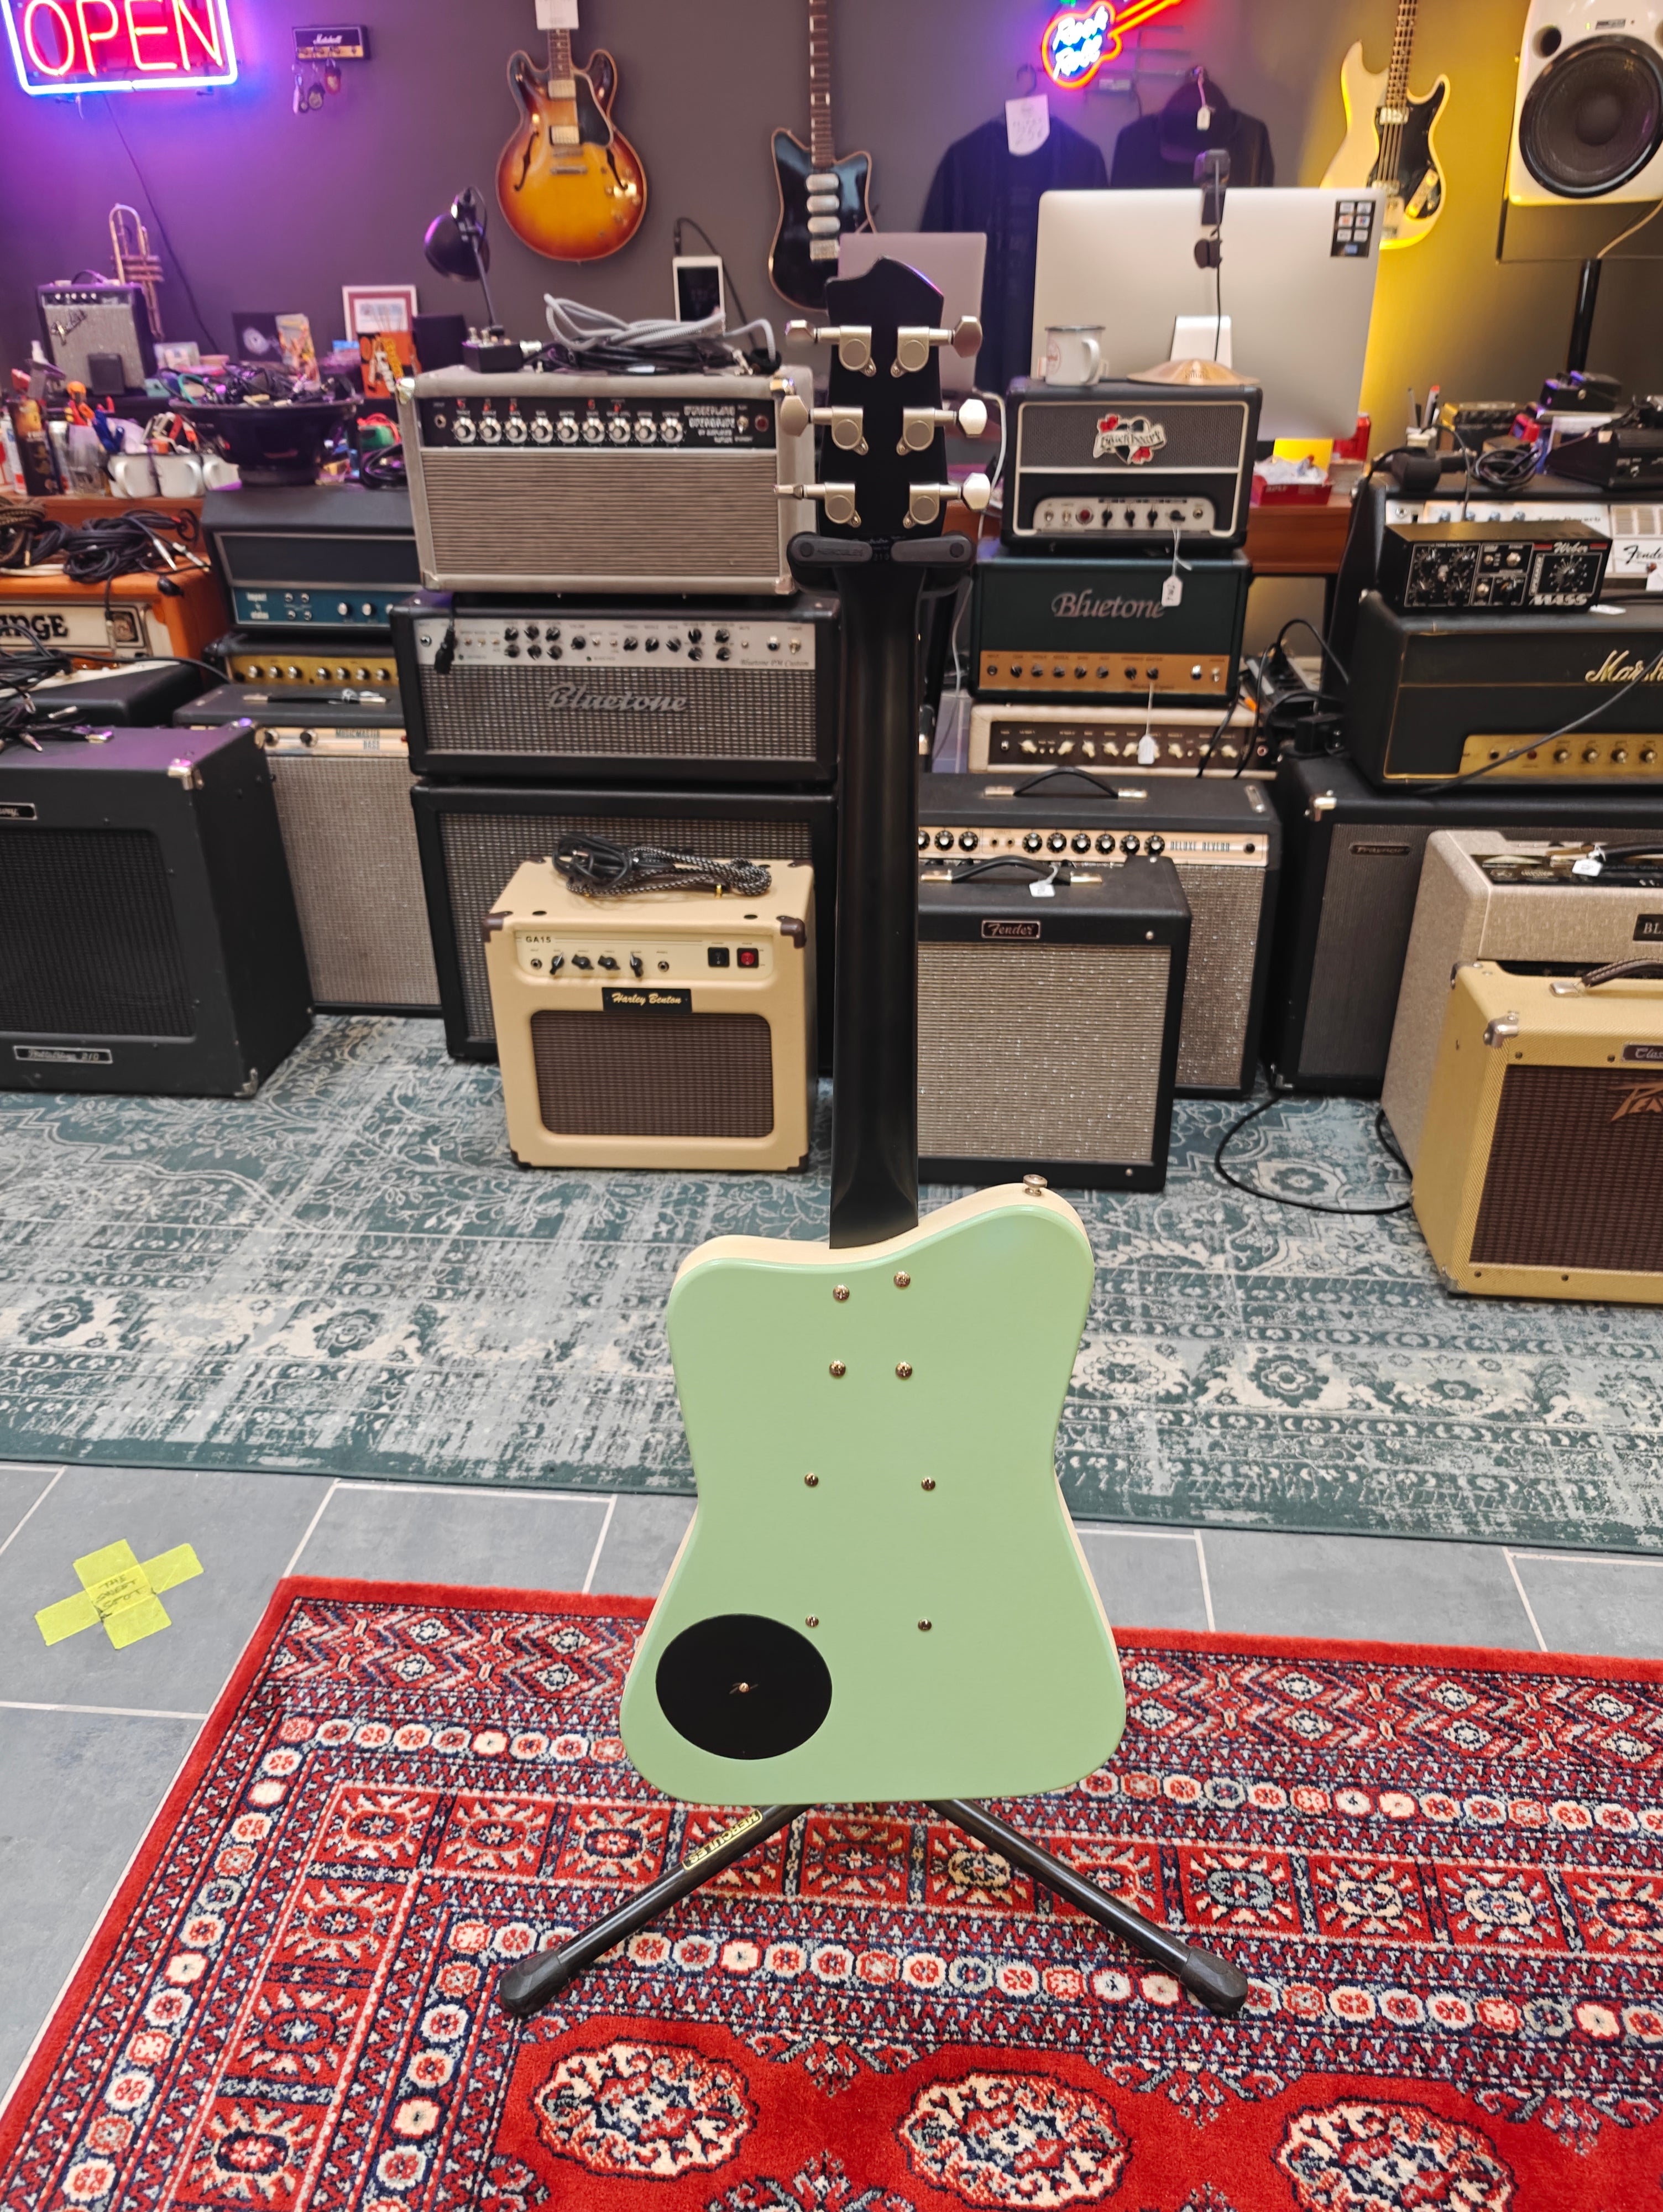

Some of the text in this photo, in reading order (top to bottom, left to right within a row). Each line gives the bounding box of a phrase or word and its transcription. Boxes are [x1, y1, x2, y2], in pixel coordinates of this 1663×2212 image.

[24, 0, 223, 76] OPEN
[1554, 541, 1588, 554] Weber
[1623, 544, 1663, 565] Fende
[1051, 588, 1165, 618] Bluetone
[1529, 594, 1587, 606] MASS
[548, 682, 687, 712] Bluetone
[1170, 841, 1230, 852] DELUXE REVERB
[988, 923, 1033, 936] Fender
[1643, 922, 1663, 935] BL
[611, 992, 682, 1006] Harley Benton
[1607, 1081, 1663, 1123] PEA
[97, 1574, 126, 1589] THE
[688, 1813, 760, 1863] HERCULES
